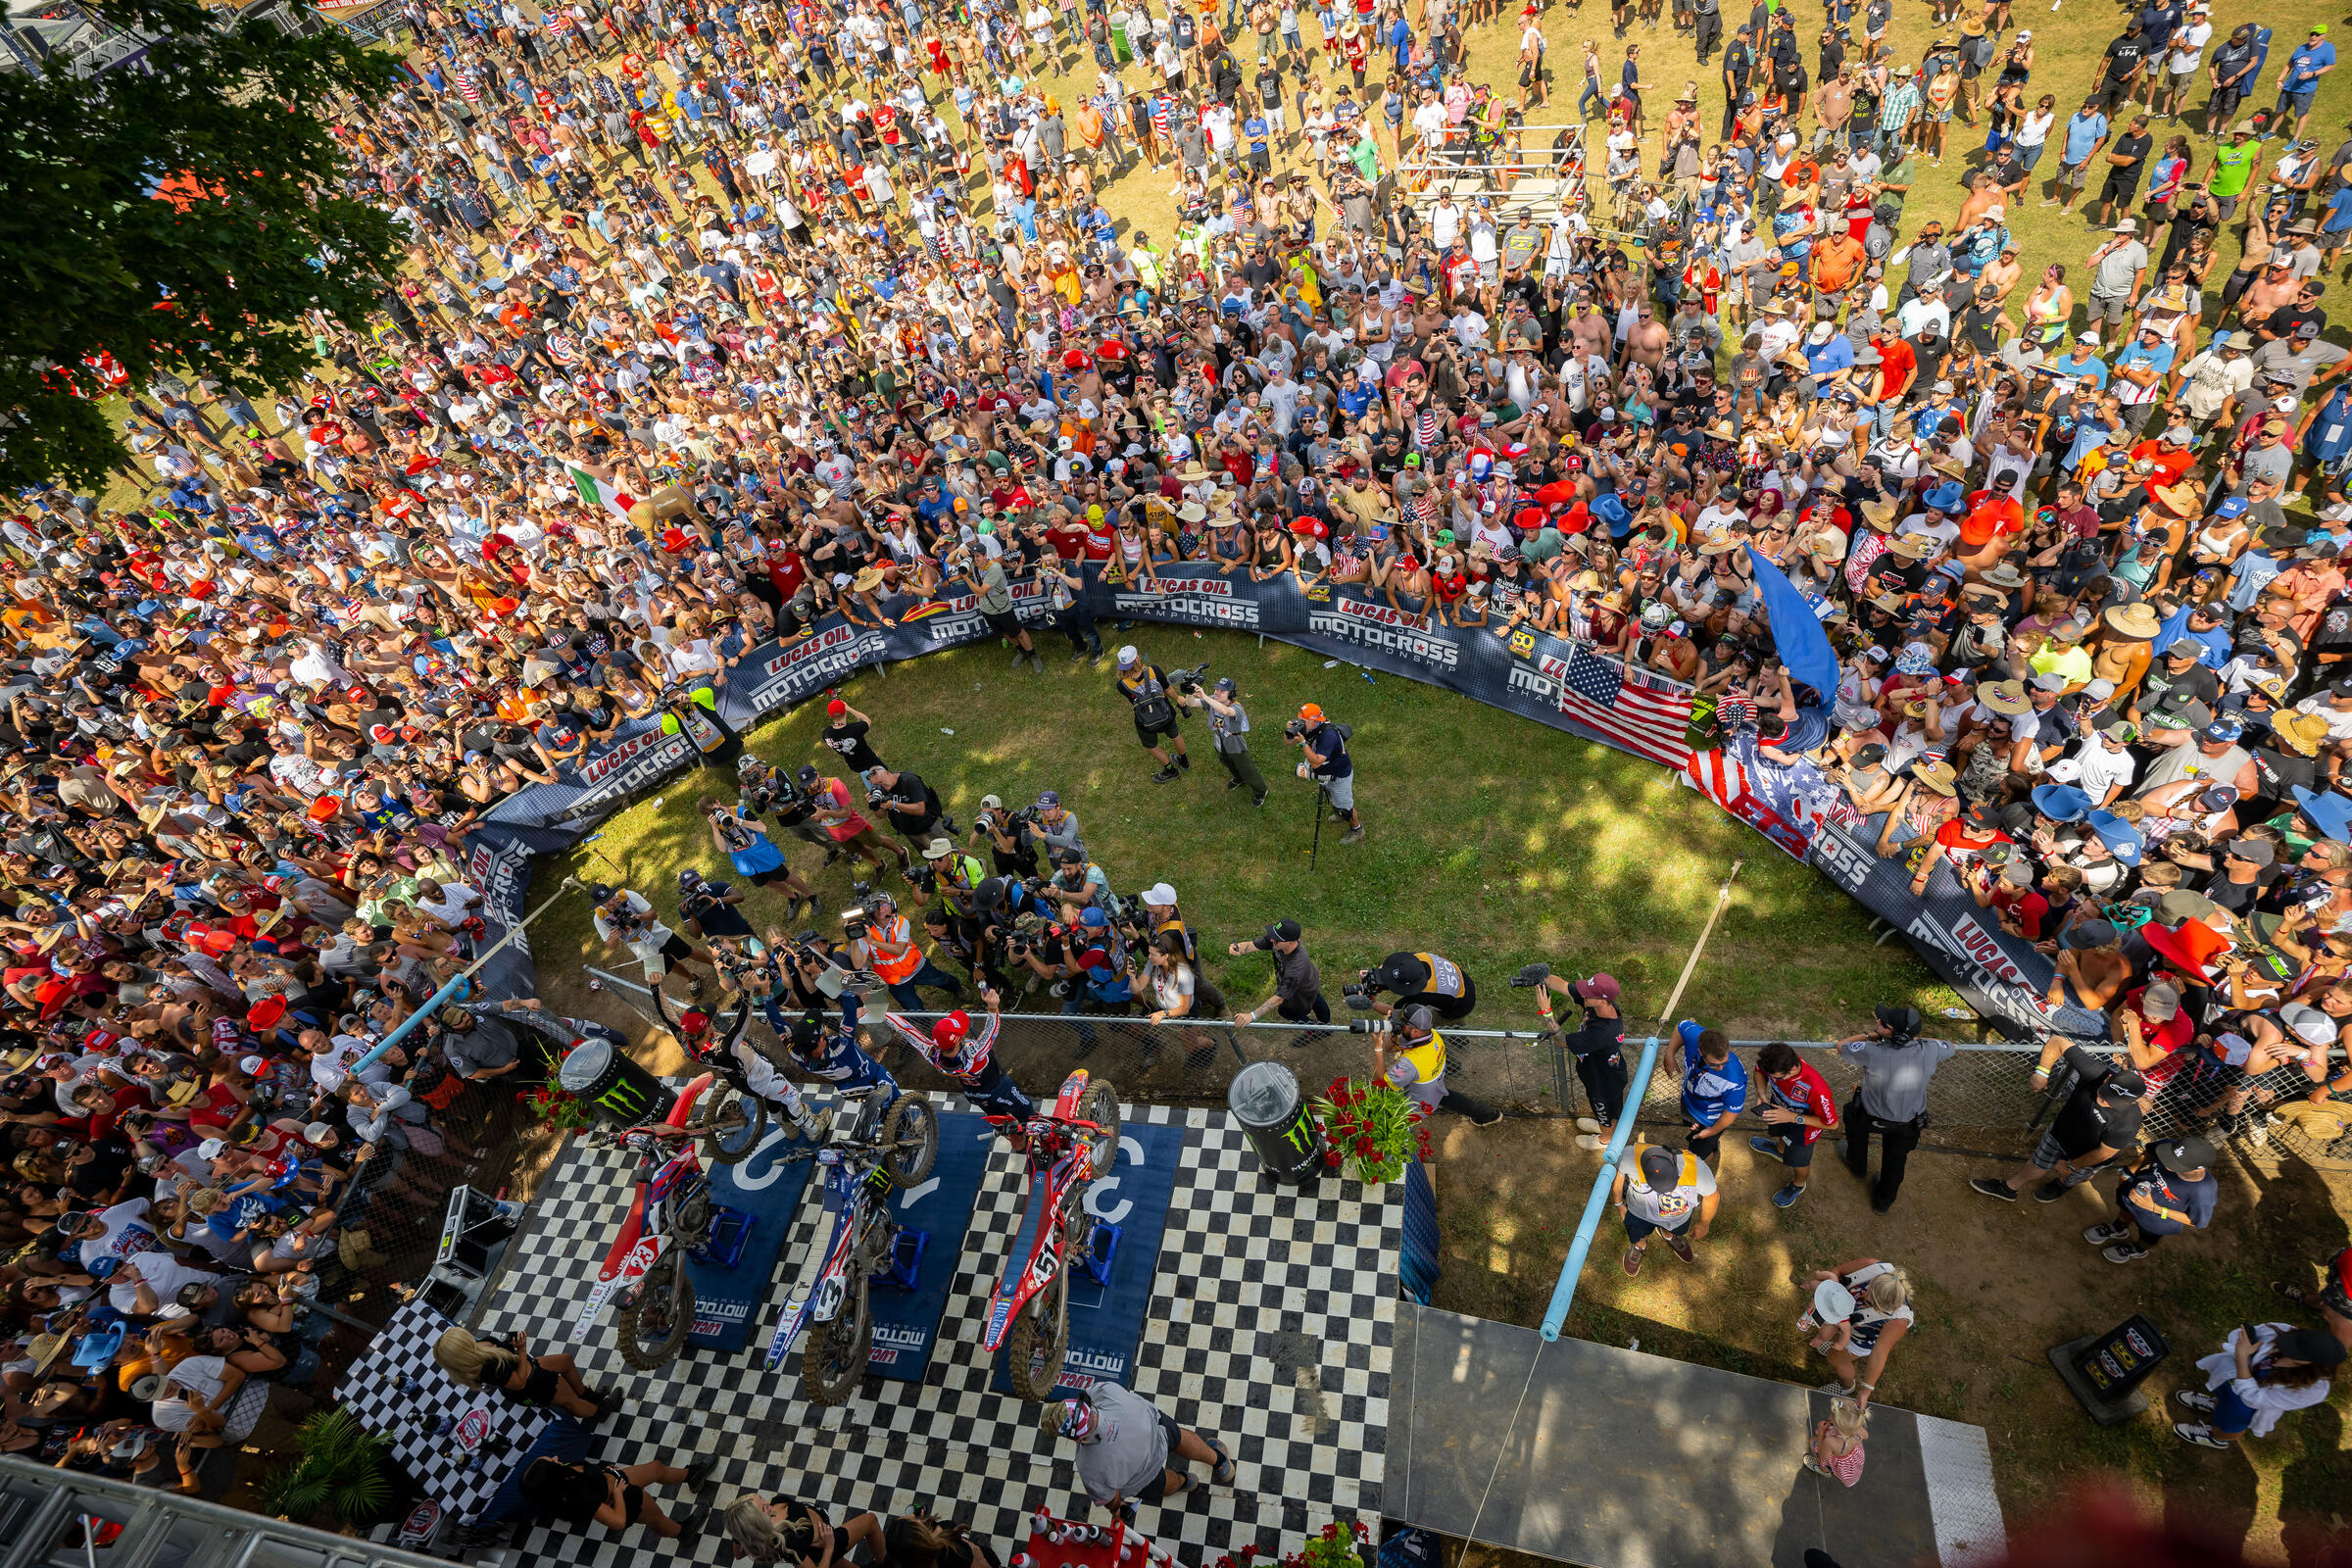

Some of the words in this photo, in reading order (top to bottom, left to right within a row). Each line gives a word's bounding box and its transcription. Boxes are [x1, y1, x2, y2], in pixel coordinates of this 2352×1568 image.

[1201, 580, 1230, 596] OIL
[1115, 598, 1259, 623] MOTOCROSS
[1342, 600, 1397, 624] LUCAS
[1363, 619, 1404, 635] PRO
[771, 638, 822, 674] LUCAS
[824, 625, 852, 646] OIL
[1309, 616, 1458, 665] MOTOCROSS
[1514, 631, 1535, 651] 50
[796, 648, 835, 670] PRO
[752, 635, 886, 711] MOTOCROSS
[1691, 708, 1710, 722] 7
[588, 740, 638, 784] LUCAS
[1955, 921, 2018, 981] LUCAS
[618, 1254, 630, 1271] USA
[630, 1245, 657, 1271] 23
[1035, 1243, 1059, 1275] 51
[820, 1278, 843, 1315] 3
[784, 1317, 805, 1351] DUNLOP
[996, 1318, 1008, 1345] DUNLOP
